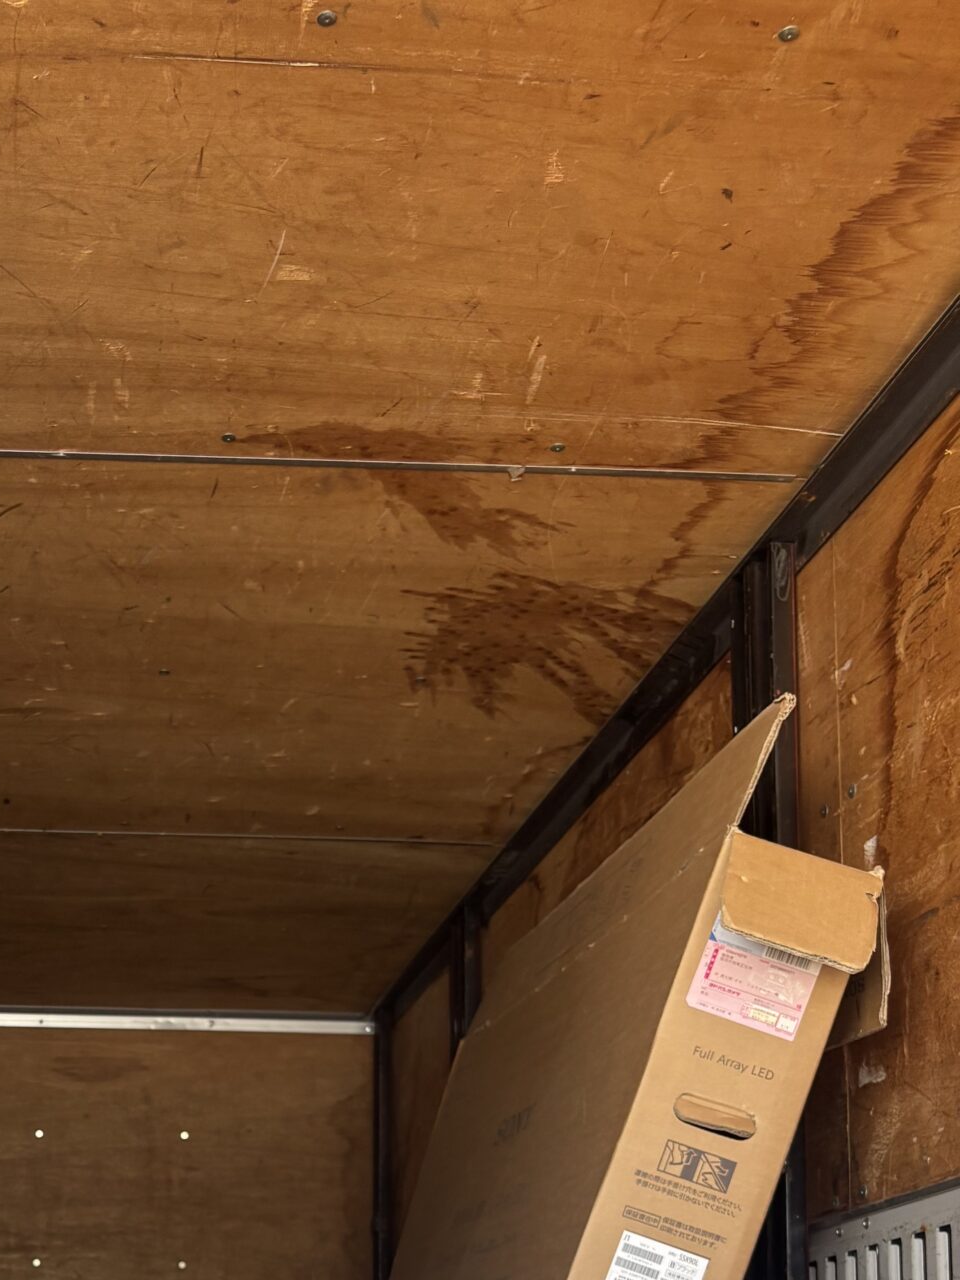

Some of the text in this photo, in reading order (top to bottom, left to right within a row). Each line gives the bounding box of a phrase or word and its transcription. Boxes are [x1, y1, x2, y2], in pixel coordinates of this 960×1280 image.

[692, 1045, 775, 1081] Full Array LED
